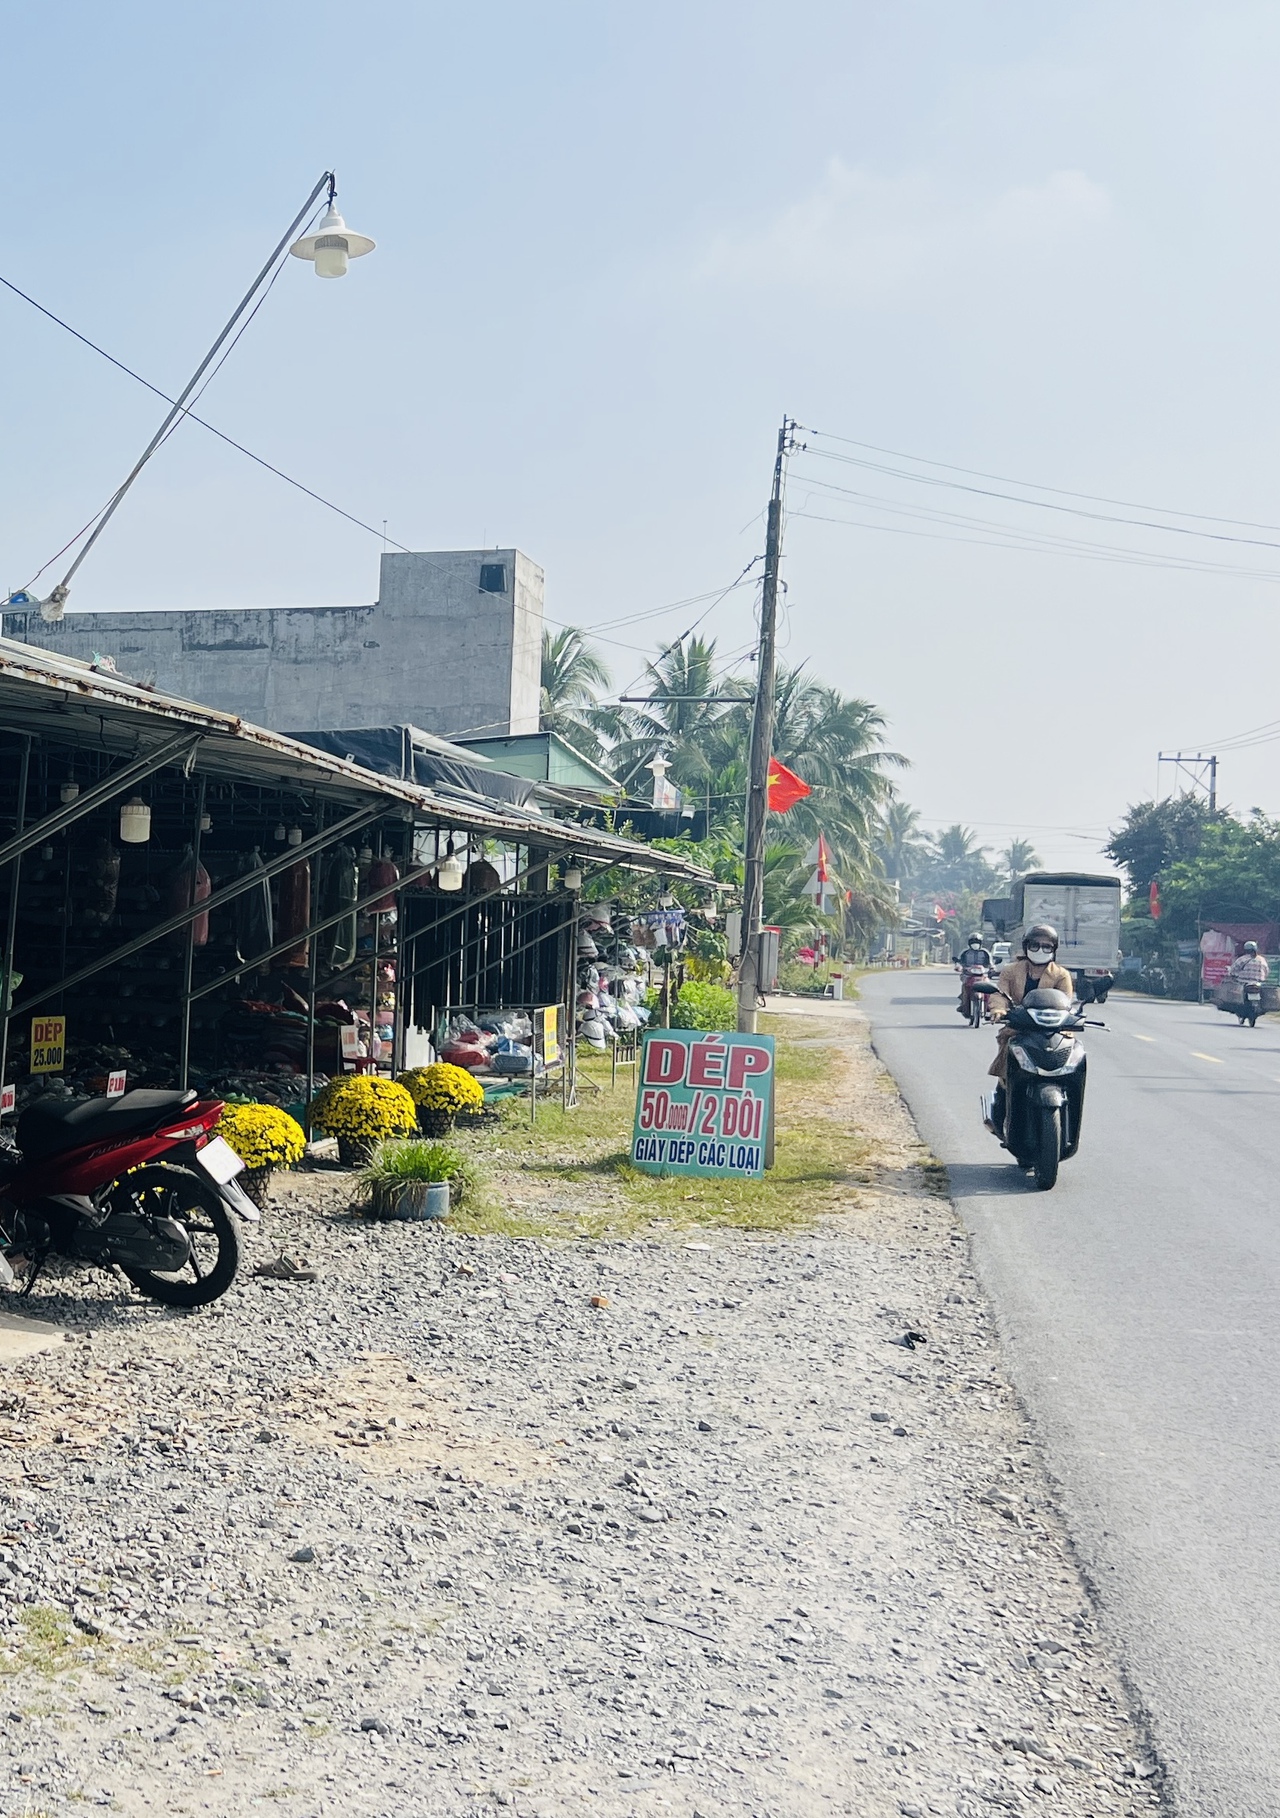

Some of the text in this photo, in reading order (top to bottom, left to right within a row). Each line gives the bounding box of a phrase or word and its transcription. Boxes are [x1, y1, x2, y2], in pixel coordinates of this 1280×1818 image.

[33, 1019, 63, 1043] DÉP
[33, 1047, 62, 1067] 25.000
[644, 1034, 771, 1090] DÉP
[722, 1090, 763, 1140] ĐÔI
[635, 1134, 761, 1176] GIÀY DÉP CÁC LOẠI
